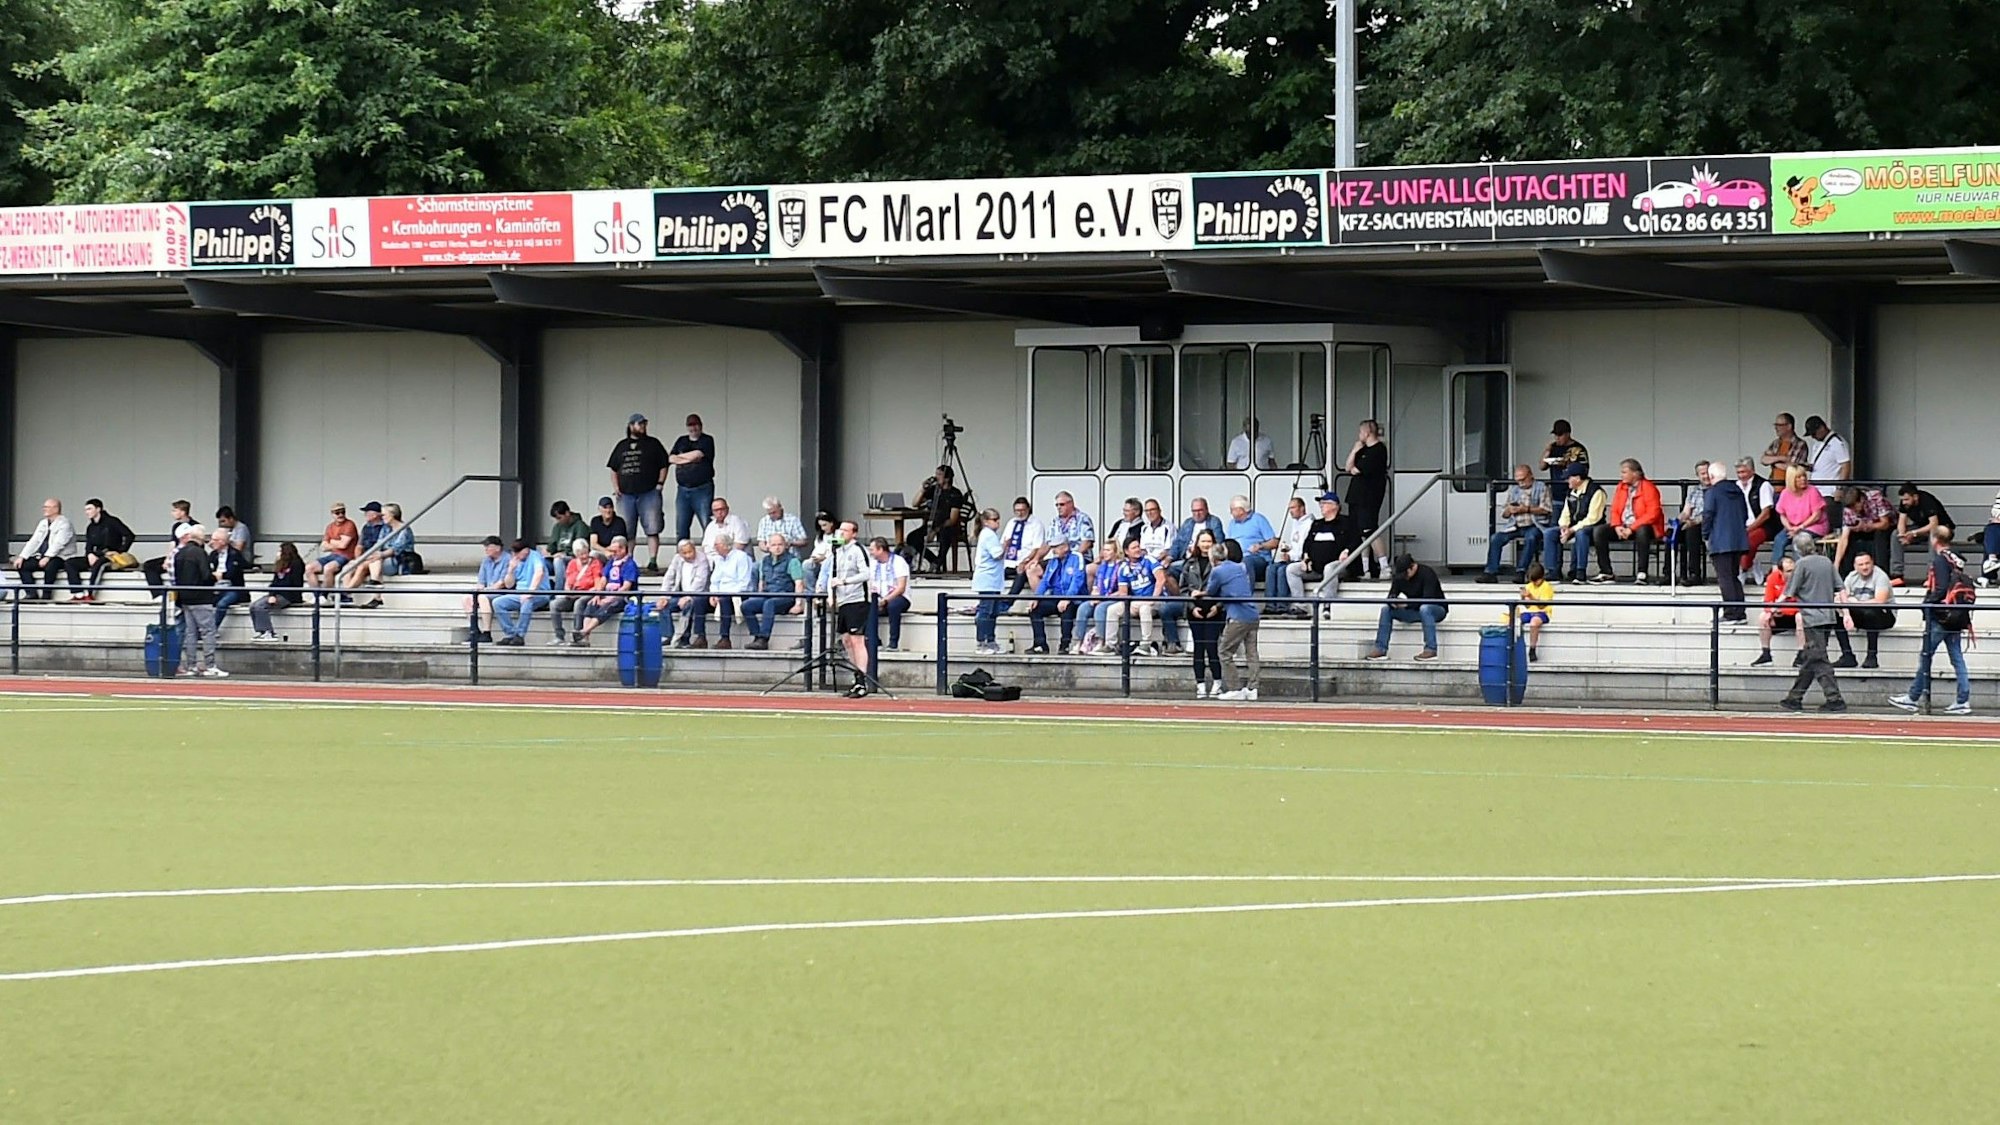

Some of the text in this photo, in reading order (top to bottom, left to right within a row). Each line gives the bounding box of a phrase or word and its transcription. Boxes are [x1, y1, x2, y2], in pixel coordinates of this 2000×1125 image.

[1329, 172, 1627, 207] KFZ-UNFALLGUTACHTEN
[1864, 160, 2000, 190] MÖBELFUN
[416, 196, 534, 215] Schornsteinsysteme
[1267, 176, 1319, 240] TEAMSPORT
[1916, 191, 2000, 203] NUR NEUWAR
[74, 208, 161, 234] AUTOVERWERTUNG
[391, 217, 561, 238] Kernbohrungen Kaminöfen
[721, 191, 768, 252] TEAMSPORT
[819, 187, 1141, 243] FC Marl 2011 e.V.
[1196, 201, 1298, 241] Philipp
[1340, 204, 1582, 231] KFZ-SACHVERSTÄNDIGENBÜRO
[1640, 211, 1767, 232] 0162 86 64 351
[193, 227, 275, 263] Philipp
[249, 204, 292, 262] TEAMSPORT
[657, 215, 749, 253] Philipp
[73, 242, 153, 268] NOTVERGLASUNG
